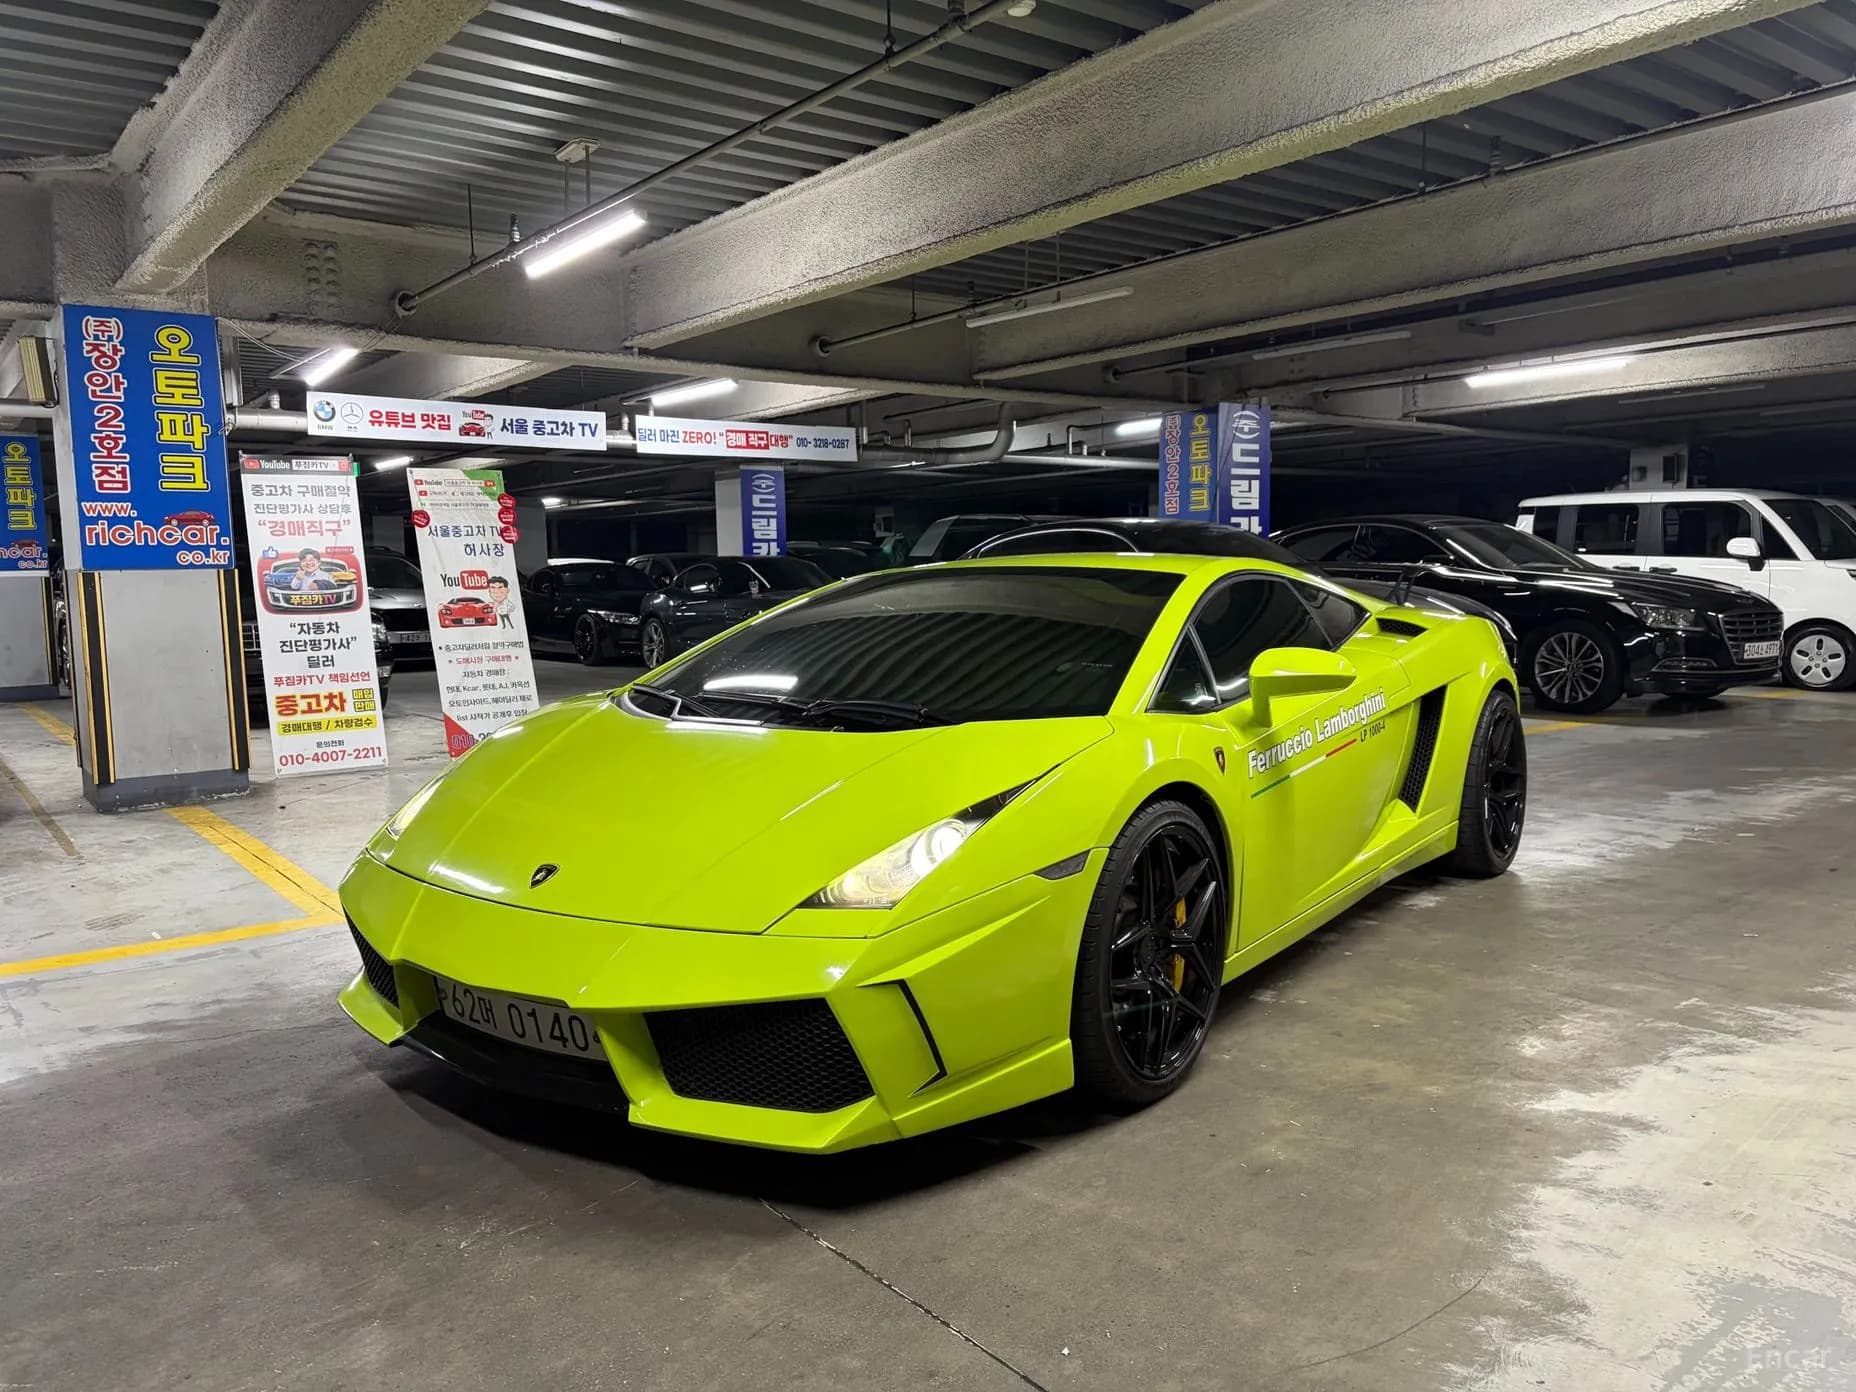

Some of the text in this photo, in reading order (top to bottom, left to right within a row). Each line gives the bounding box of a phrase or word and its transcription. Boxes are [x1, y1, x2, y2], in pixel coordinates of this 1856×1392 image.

[82, 315, 131, 493] (주)장안2호점
[150, 325, 209, 491] 오토파크
[368, 409, 451, 431] 유튜브 맛집
[501, 417, 598, 438] 서울 중고차 TV
[638, 428, 656, 442] 딜러
[659, 429, 680, 443] 마진
[682, 430, 717, 445] ZERO!
[748, 432, 769, 448] 직구
[813, 438, 850, 449] 3218-0287
[260, 459, 290, 470] YouTube
[1189, 412, 1211, 512] 오토파크
[2, 442, 37, 530] 오토파크
[251, 484, 350, 497] 중고차 구매절약
[82, 503, 137, 517] www.
[254, 503, 351, 514] 진단평가사 상담후
[86, 521, 229, 545] richcar.
[428, 525, 486, 537] 서울중고차
[177, 549, 230, 565] co.kr
[290, 621, 340, 635] “자동차
[280, 636, 357, 653] 진단평가사”
[307, 655, 335, 668] 딜러
[329, 671, 371, 683] 책임선언
[463, 669, 483, 678] 자동차
[353, 688, 374, 699] 매입
[275, 692, 347, 716] 중고차
[354, 701, 376, 712] 판매
[281, 721, 322, 733] 경매대행
[334, 719, 373, 730] 차량검수
[1248, 687, 1387, 779] Ferruccio Lamborghini
[316, 740, 345, 749] 문의전화
[279, 747, 382, 767] 010-4007-2211
[452, 984, 589, 1051] 62머 0140
